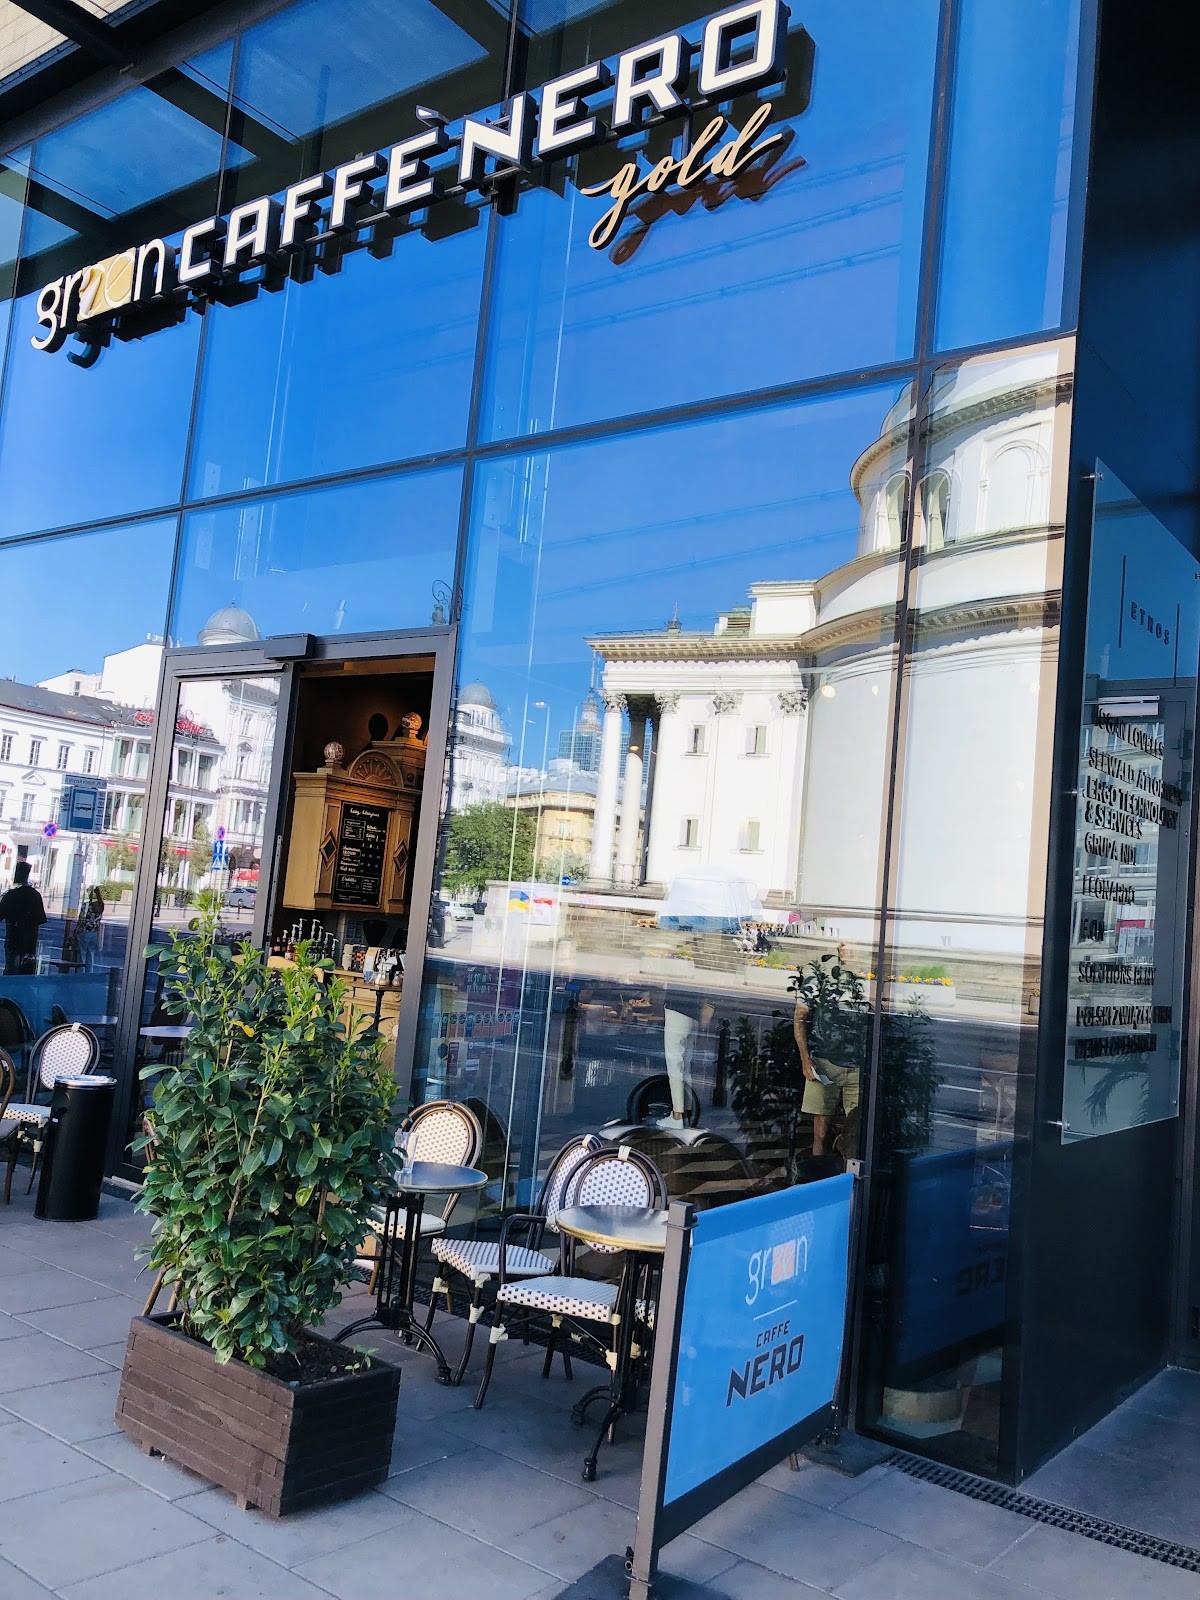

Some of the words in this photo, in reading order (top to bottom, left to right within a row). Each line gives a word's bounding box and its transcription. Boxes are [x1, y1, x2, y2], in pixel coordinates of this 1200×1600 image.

[457, 0, 780, 184] NERO
[579, 102, 784, 248] gold
[1084, 832, 1118, 860] GRUPA
[1095, 803, 1142, 839] SERVICES
[745, 1235, 808, 1305] green
[725, 1333, 805, 1408] NERO
